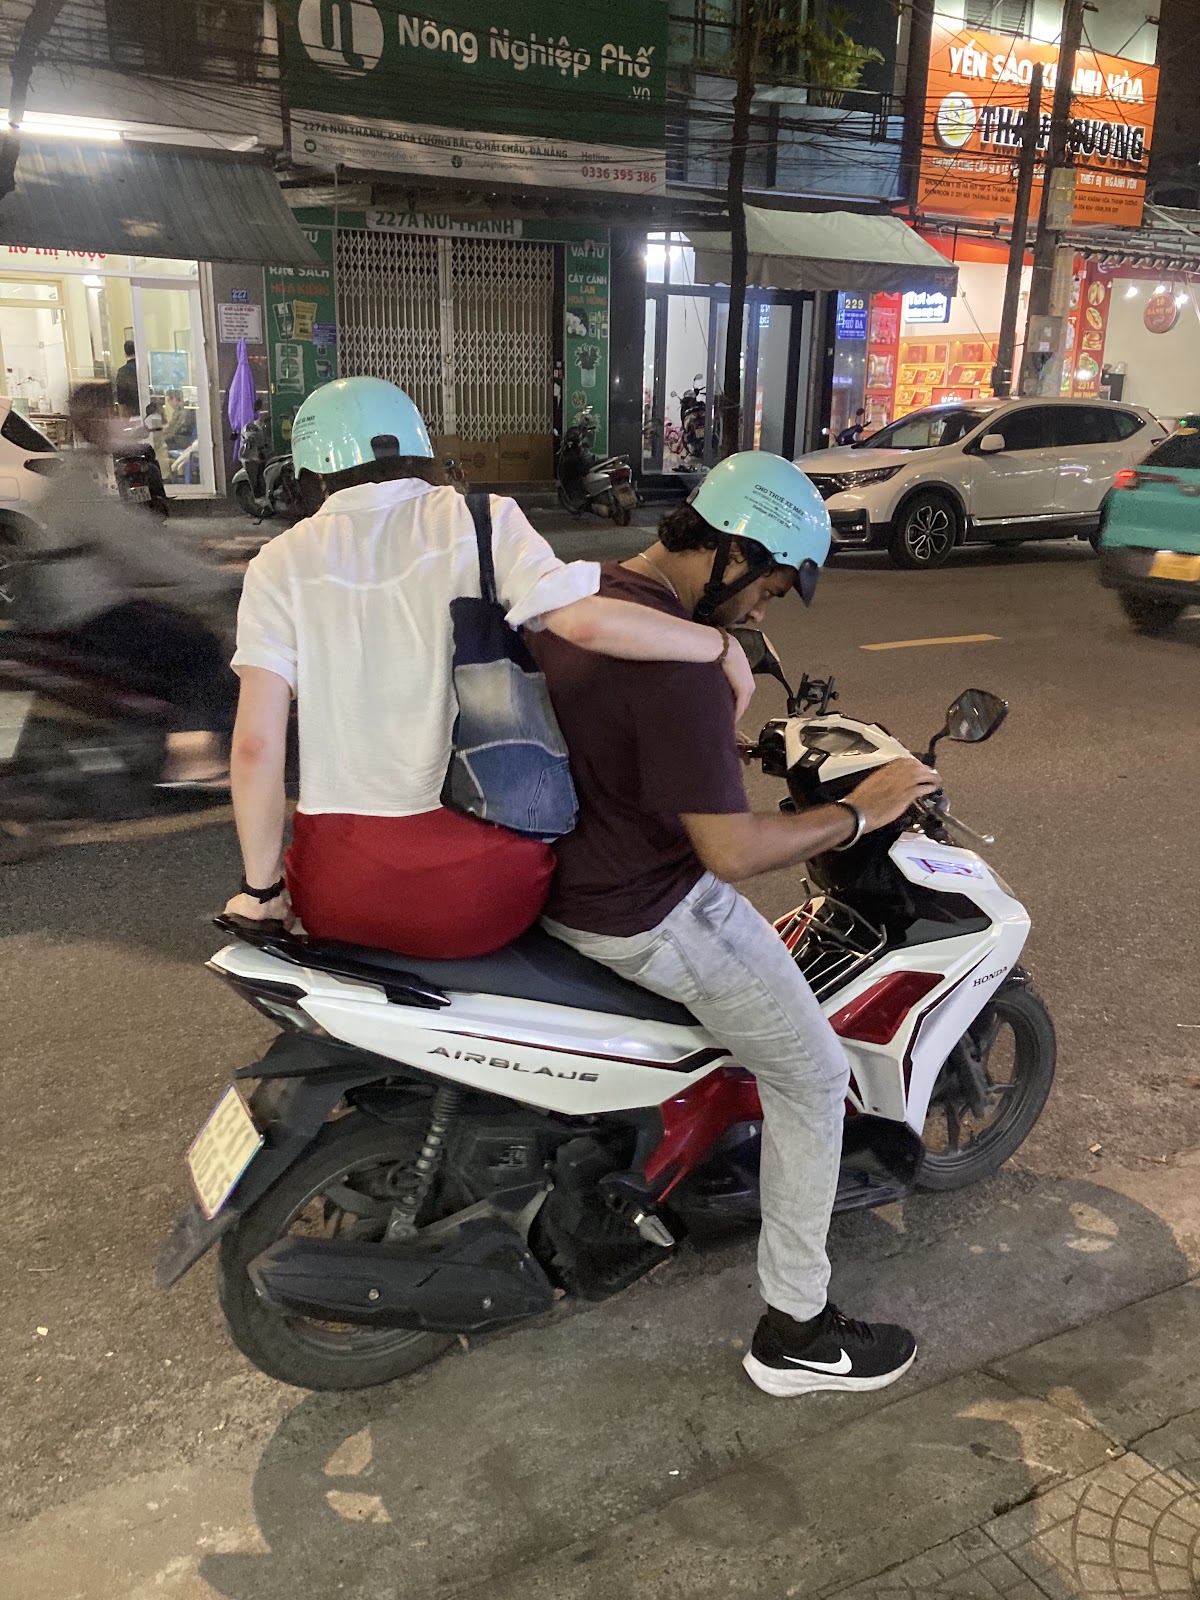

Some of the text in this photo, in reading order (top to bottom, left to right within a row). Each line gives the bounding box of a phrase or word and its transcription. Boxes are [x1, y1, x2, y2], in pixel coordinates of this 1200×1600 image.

[398, 13, 656, 78] Nông Nghiệp Phố
[949, 39, 988, 79] YẾN
[1105, 69, 1145, 105] HÒA
[582, 165, 657, 183] 0336 395 386
[376, 210, 419, 228] 227A
[231, 289, 247, 299] 227
[845, 298, 864, 309] 229
[755, 484, 768, 494] CHO
[769, 490, 785, 503] THUÊ
[785, 500, 793, 508] XE
[973, 966, 1008, 987] HONDA
